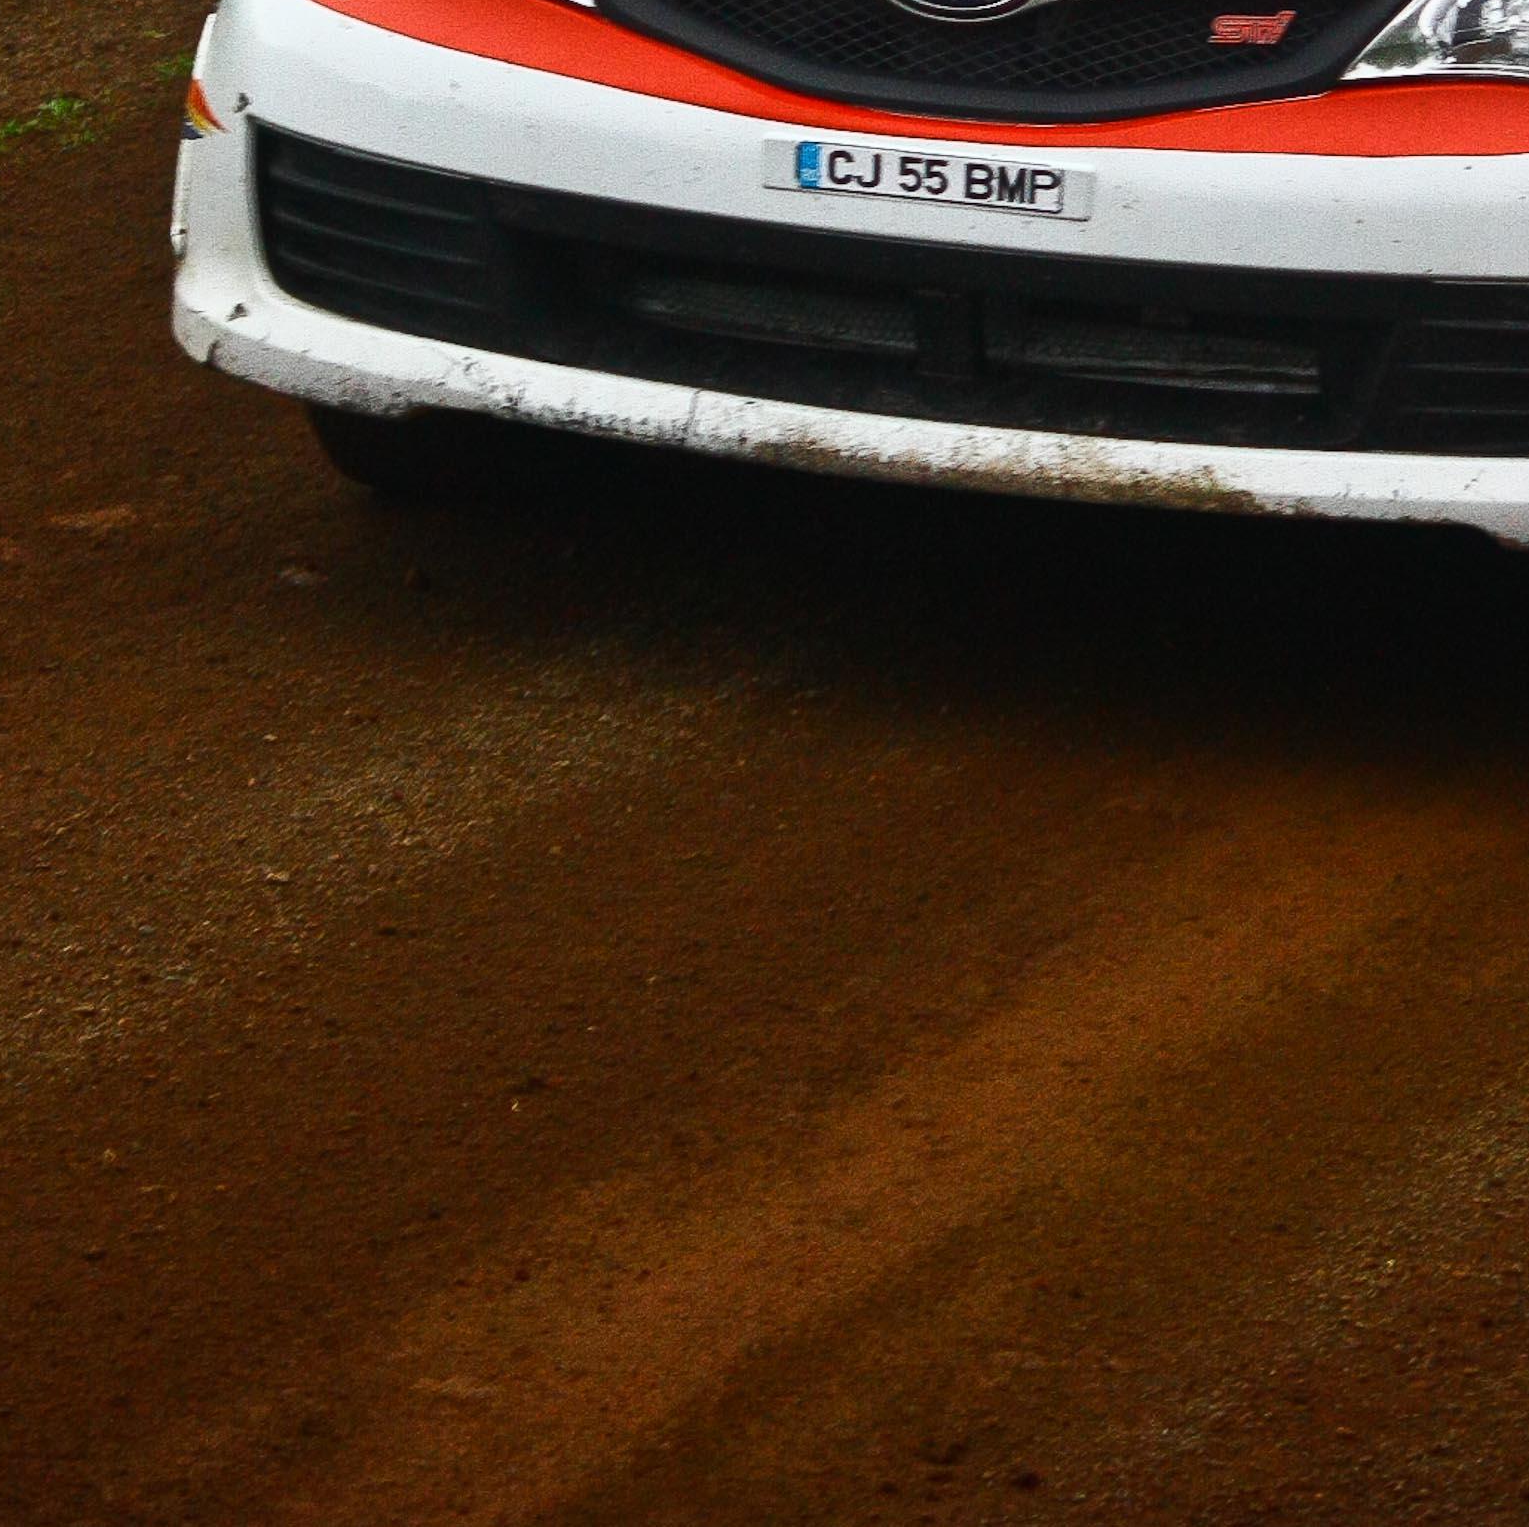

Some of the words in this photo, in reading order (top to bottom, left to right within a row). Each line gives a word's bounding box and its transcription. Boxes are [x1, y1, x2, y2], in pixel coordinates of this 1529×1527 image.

[828, 150, 882, 189] CJ
[898, 156, 950, 196] 55
[964, 162, 1063, 205] BMP
